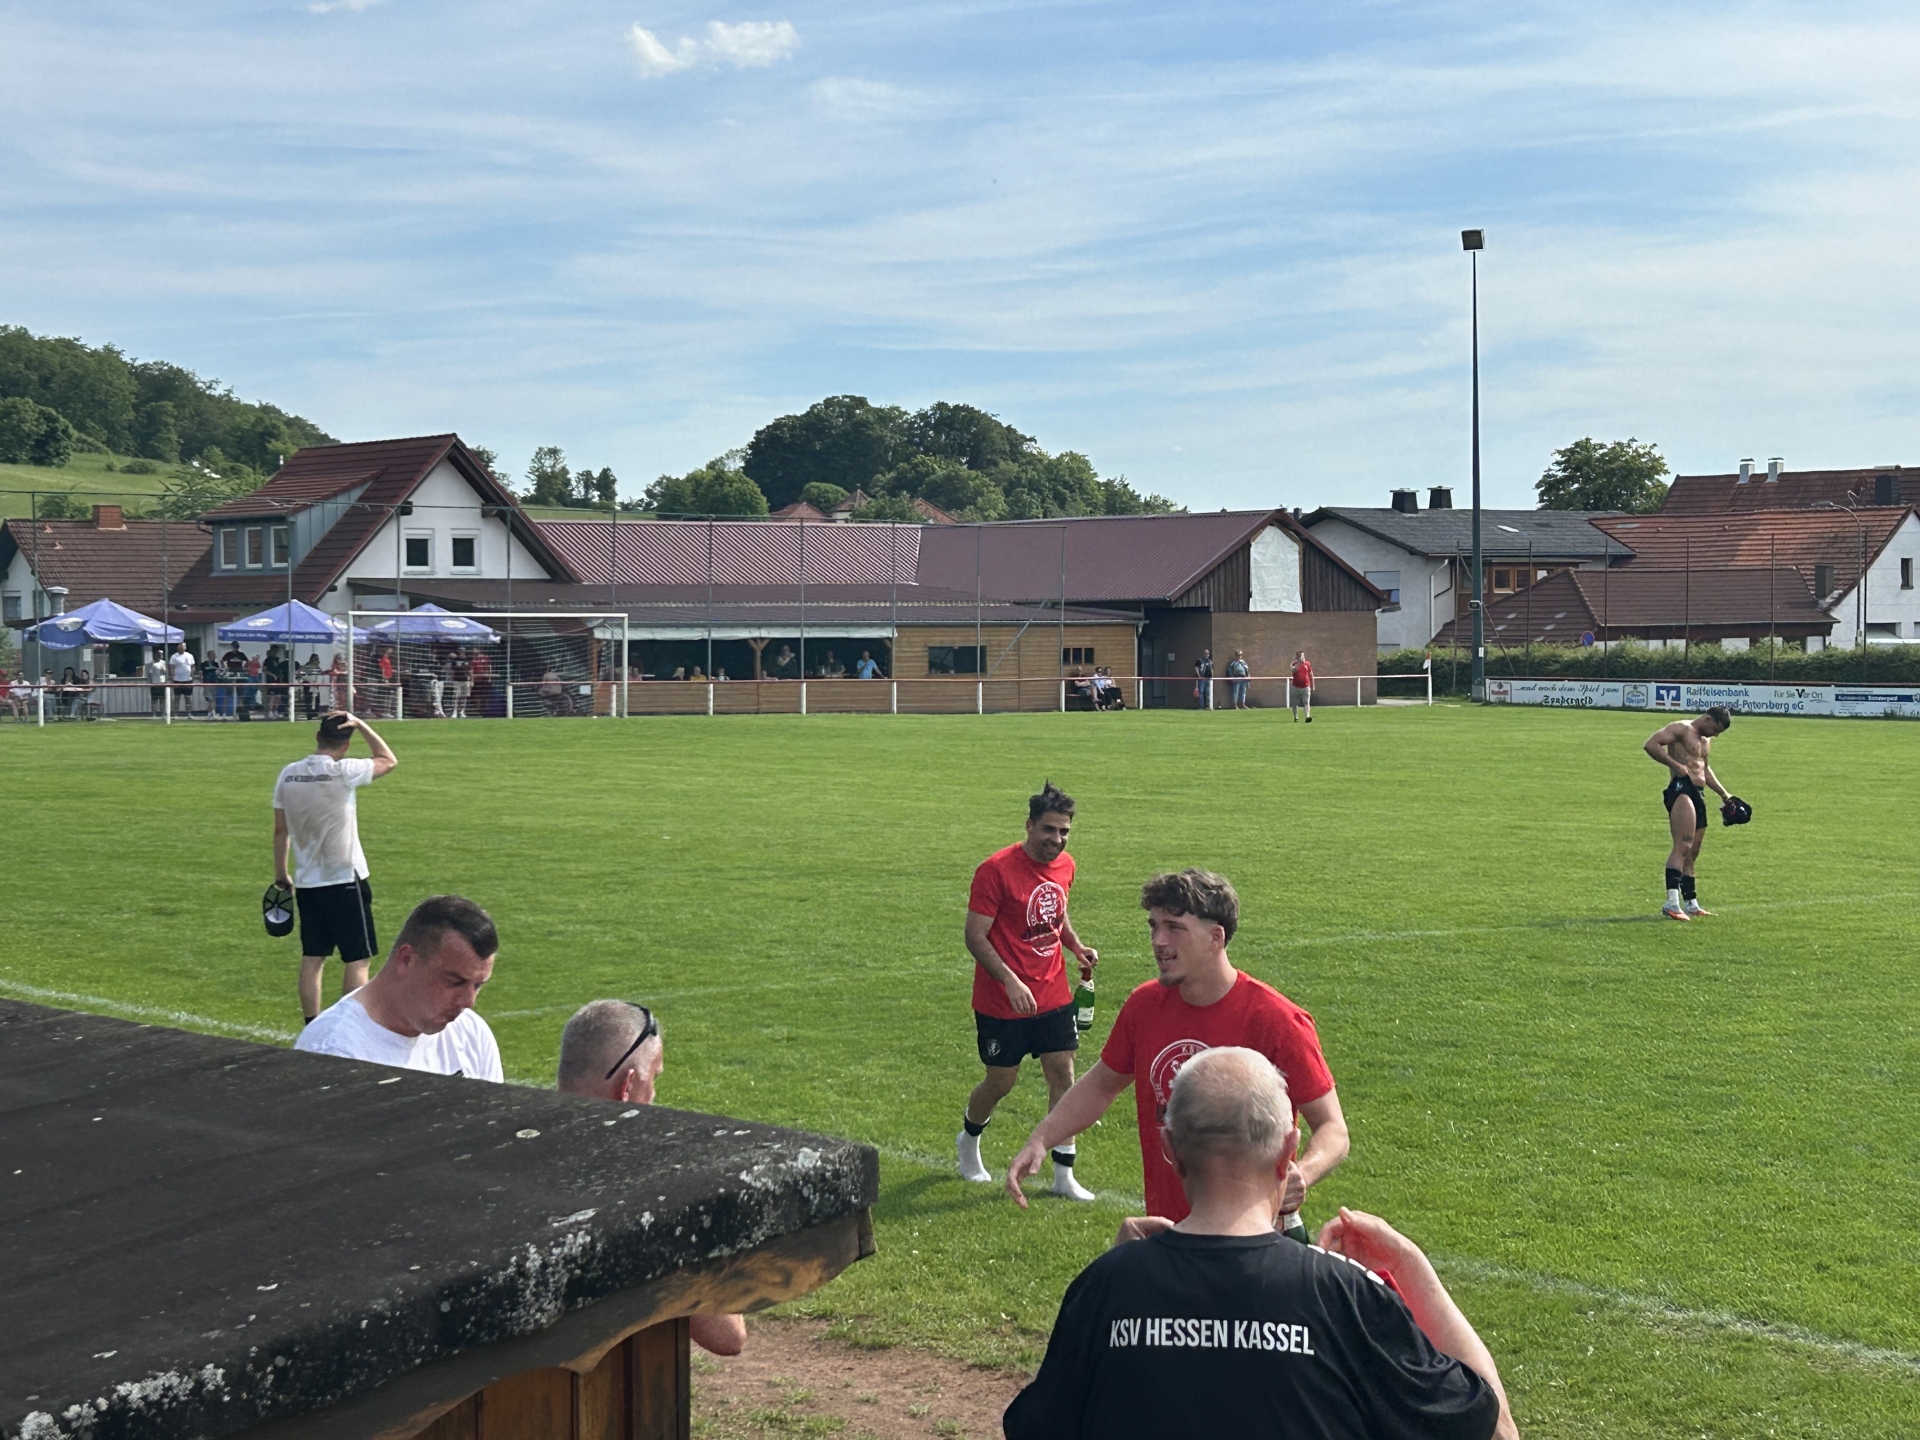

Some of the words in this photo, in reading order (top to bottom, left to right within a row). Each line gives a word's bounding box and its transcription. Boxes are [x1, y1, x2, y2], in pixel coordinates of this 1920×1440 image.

[1558, 683, 1576, 692] dem
[1578, 683, 1600, 696] Spiel
[1601, 687, 1619, 697] zum
[1686, 686, 1750, 697] Raiffeisenbank
[1786, 690, 1796, 698] Sie
[1811, 691, 1823, 699] Ort
[1792, 700, 1804, 710] eG
[1109, 1318, 1142, 1348] KSV
[1146, 1317, 1228, 1348] HESSEN
[1233, 1319, 1315, 1356] KASSEL
